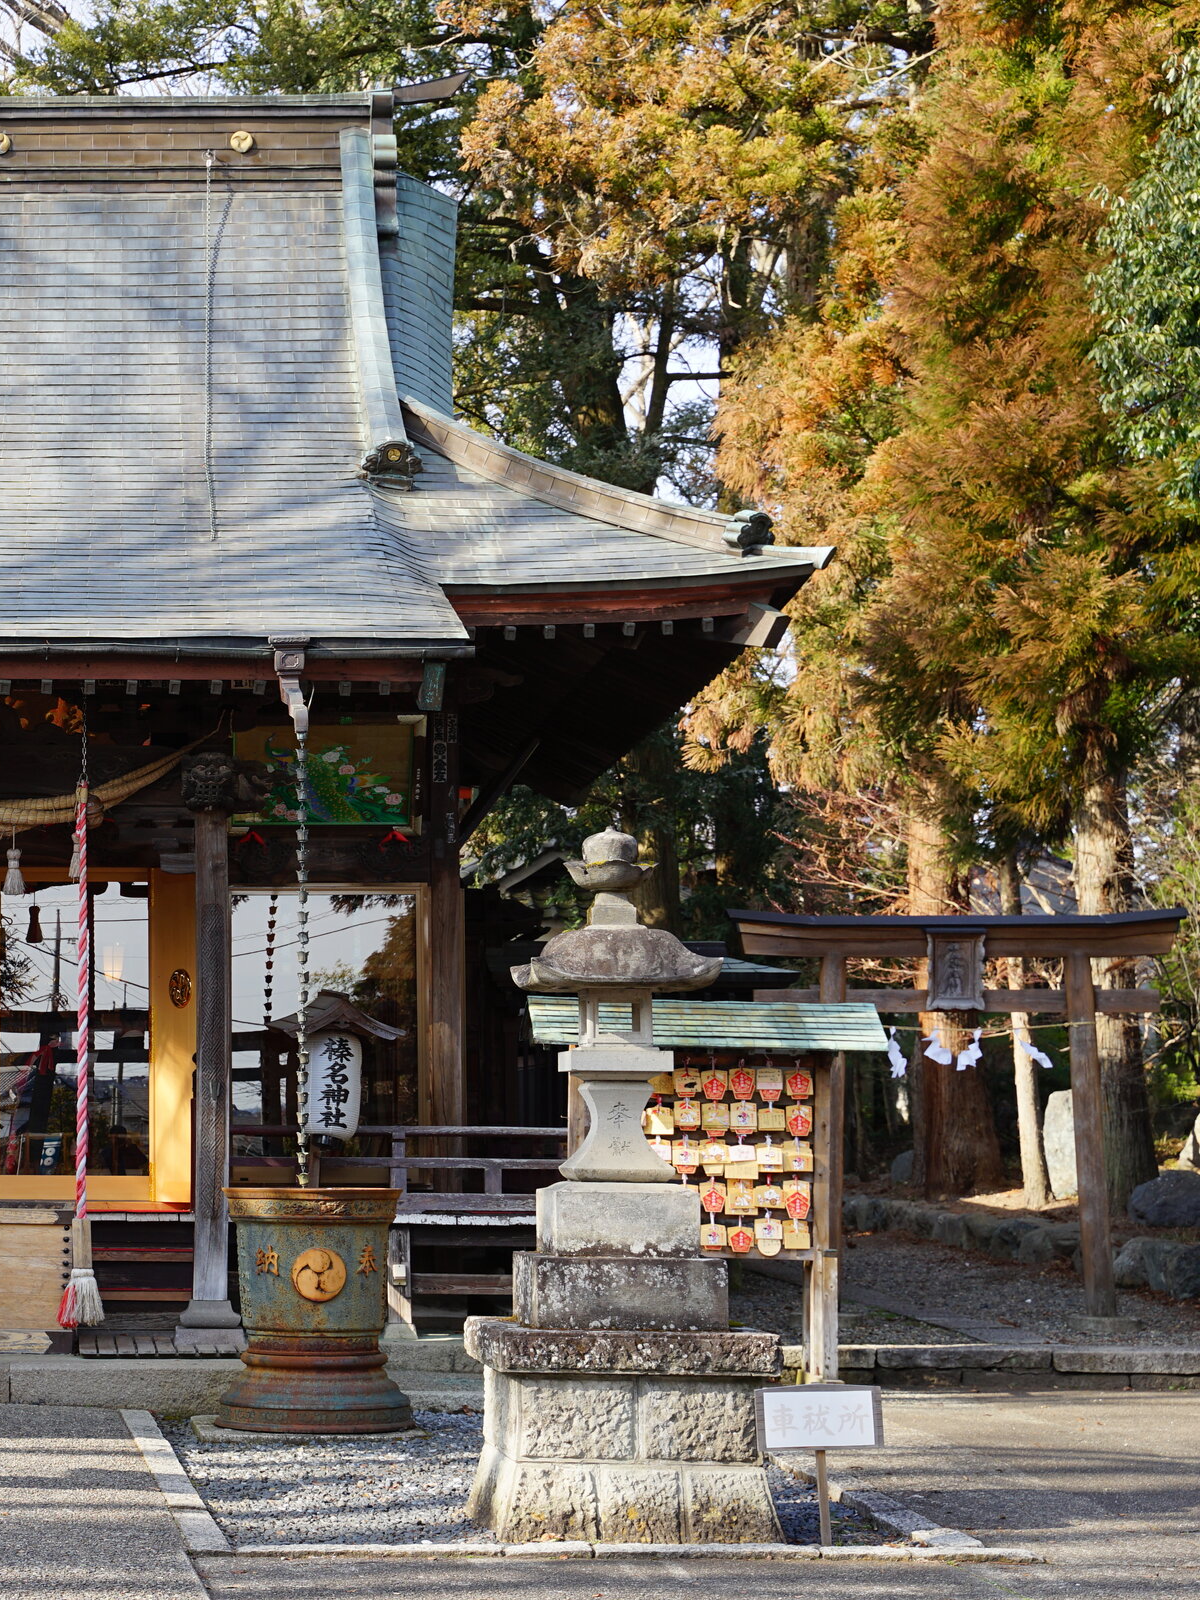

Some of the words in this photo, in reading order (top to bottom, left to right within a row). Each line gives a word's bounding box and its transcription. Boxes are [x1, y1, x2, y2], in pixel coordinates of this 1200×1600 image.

[315, 1037, 354, 1129] 榛名神社
[255, 1244, 280, 1277] 納
[356, 1244, 379, 1278] 奉
[769, 1403, 871, 1438] 車祓所
